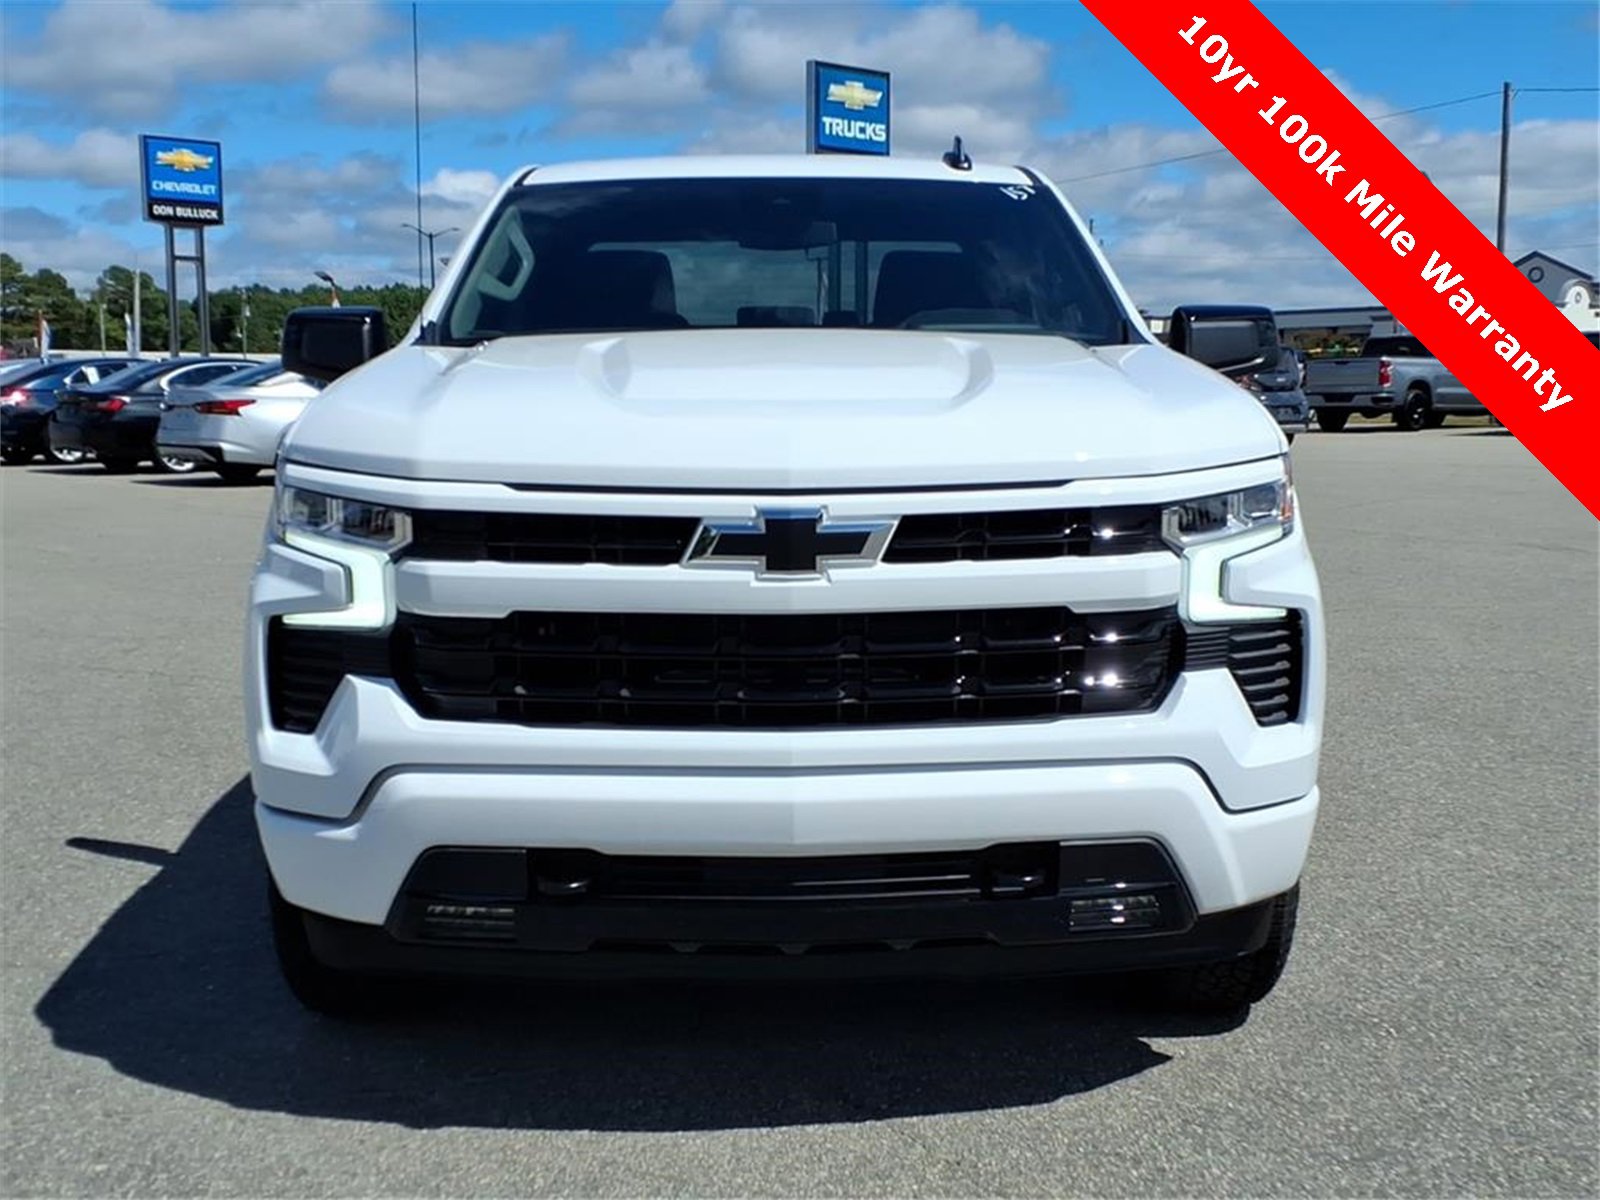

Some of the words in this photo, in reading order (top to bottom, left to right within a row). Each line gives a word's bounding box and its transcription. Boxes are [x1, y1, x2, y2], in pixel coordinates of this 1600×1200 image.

[821, 116, 886, 142] TRUCKS
[151, 180, 217, 195] CHEVROLET
[152, 204, 174, 216] DON
